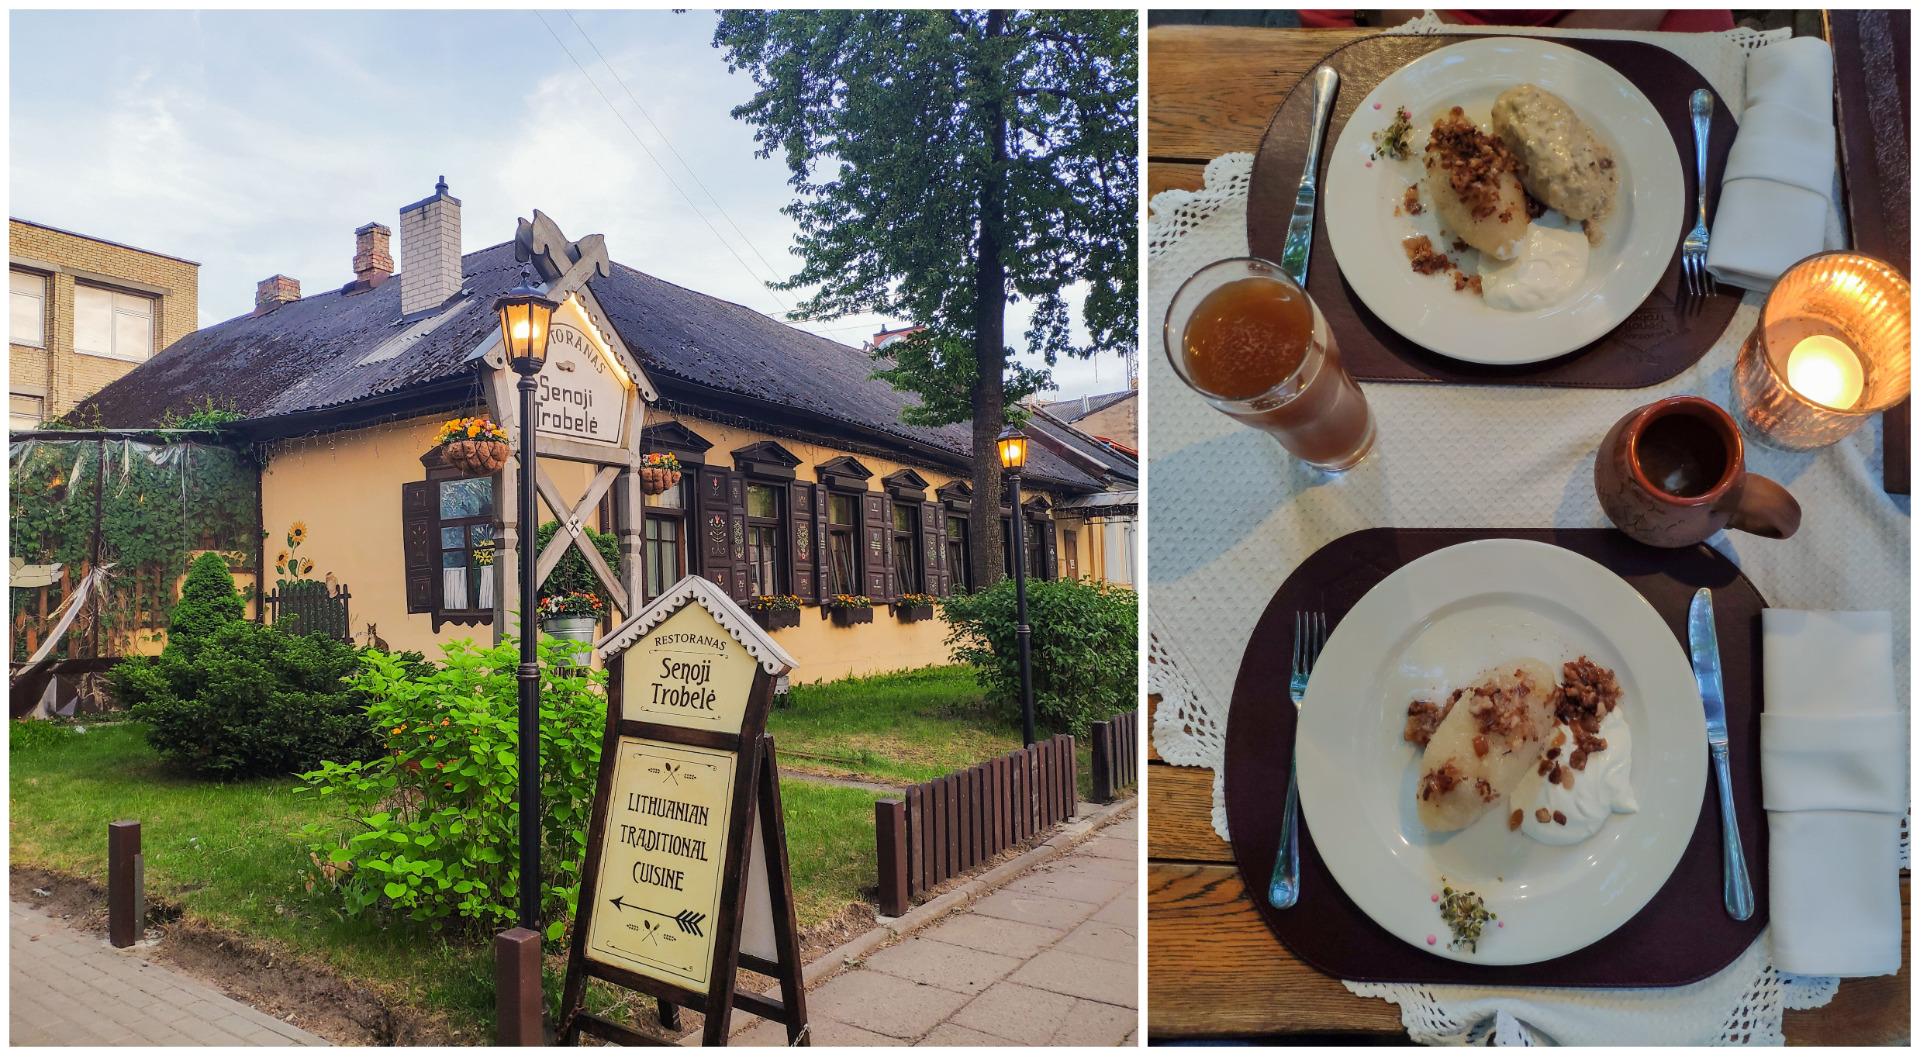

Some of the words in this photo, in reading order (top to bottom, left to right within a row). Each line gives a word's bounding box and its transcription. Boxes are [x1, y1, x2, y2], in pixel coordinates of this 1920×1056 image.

[550, 328, 606, 375] TORANAS
[540, 375, 593, 411] Senoji
[535, 402, 598, 435] Trobelė
[655, 633, 727, 651] RESTORANAS
[660, 657, 712, 686] Senoji
[651, 683, 717, 711] Trobelė
[627, 793, 710, 827] LITHUANIAN
[620, 824, 708, 862] TRADITIONAL
[632, 861, 685, 892] CUISINE
